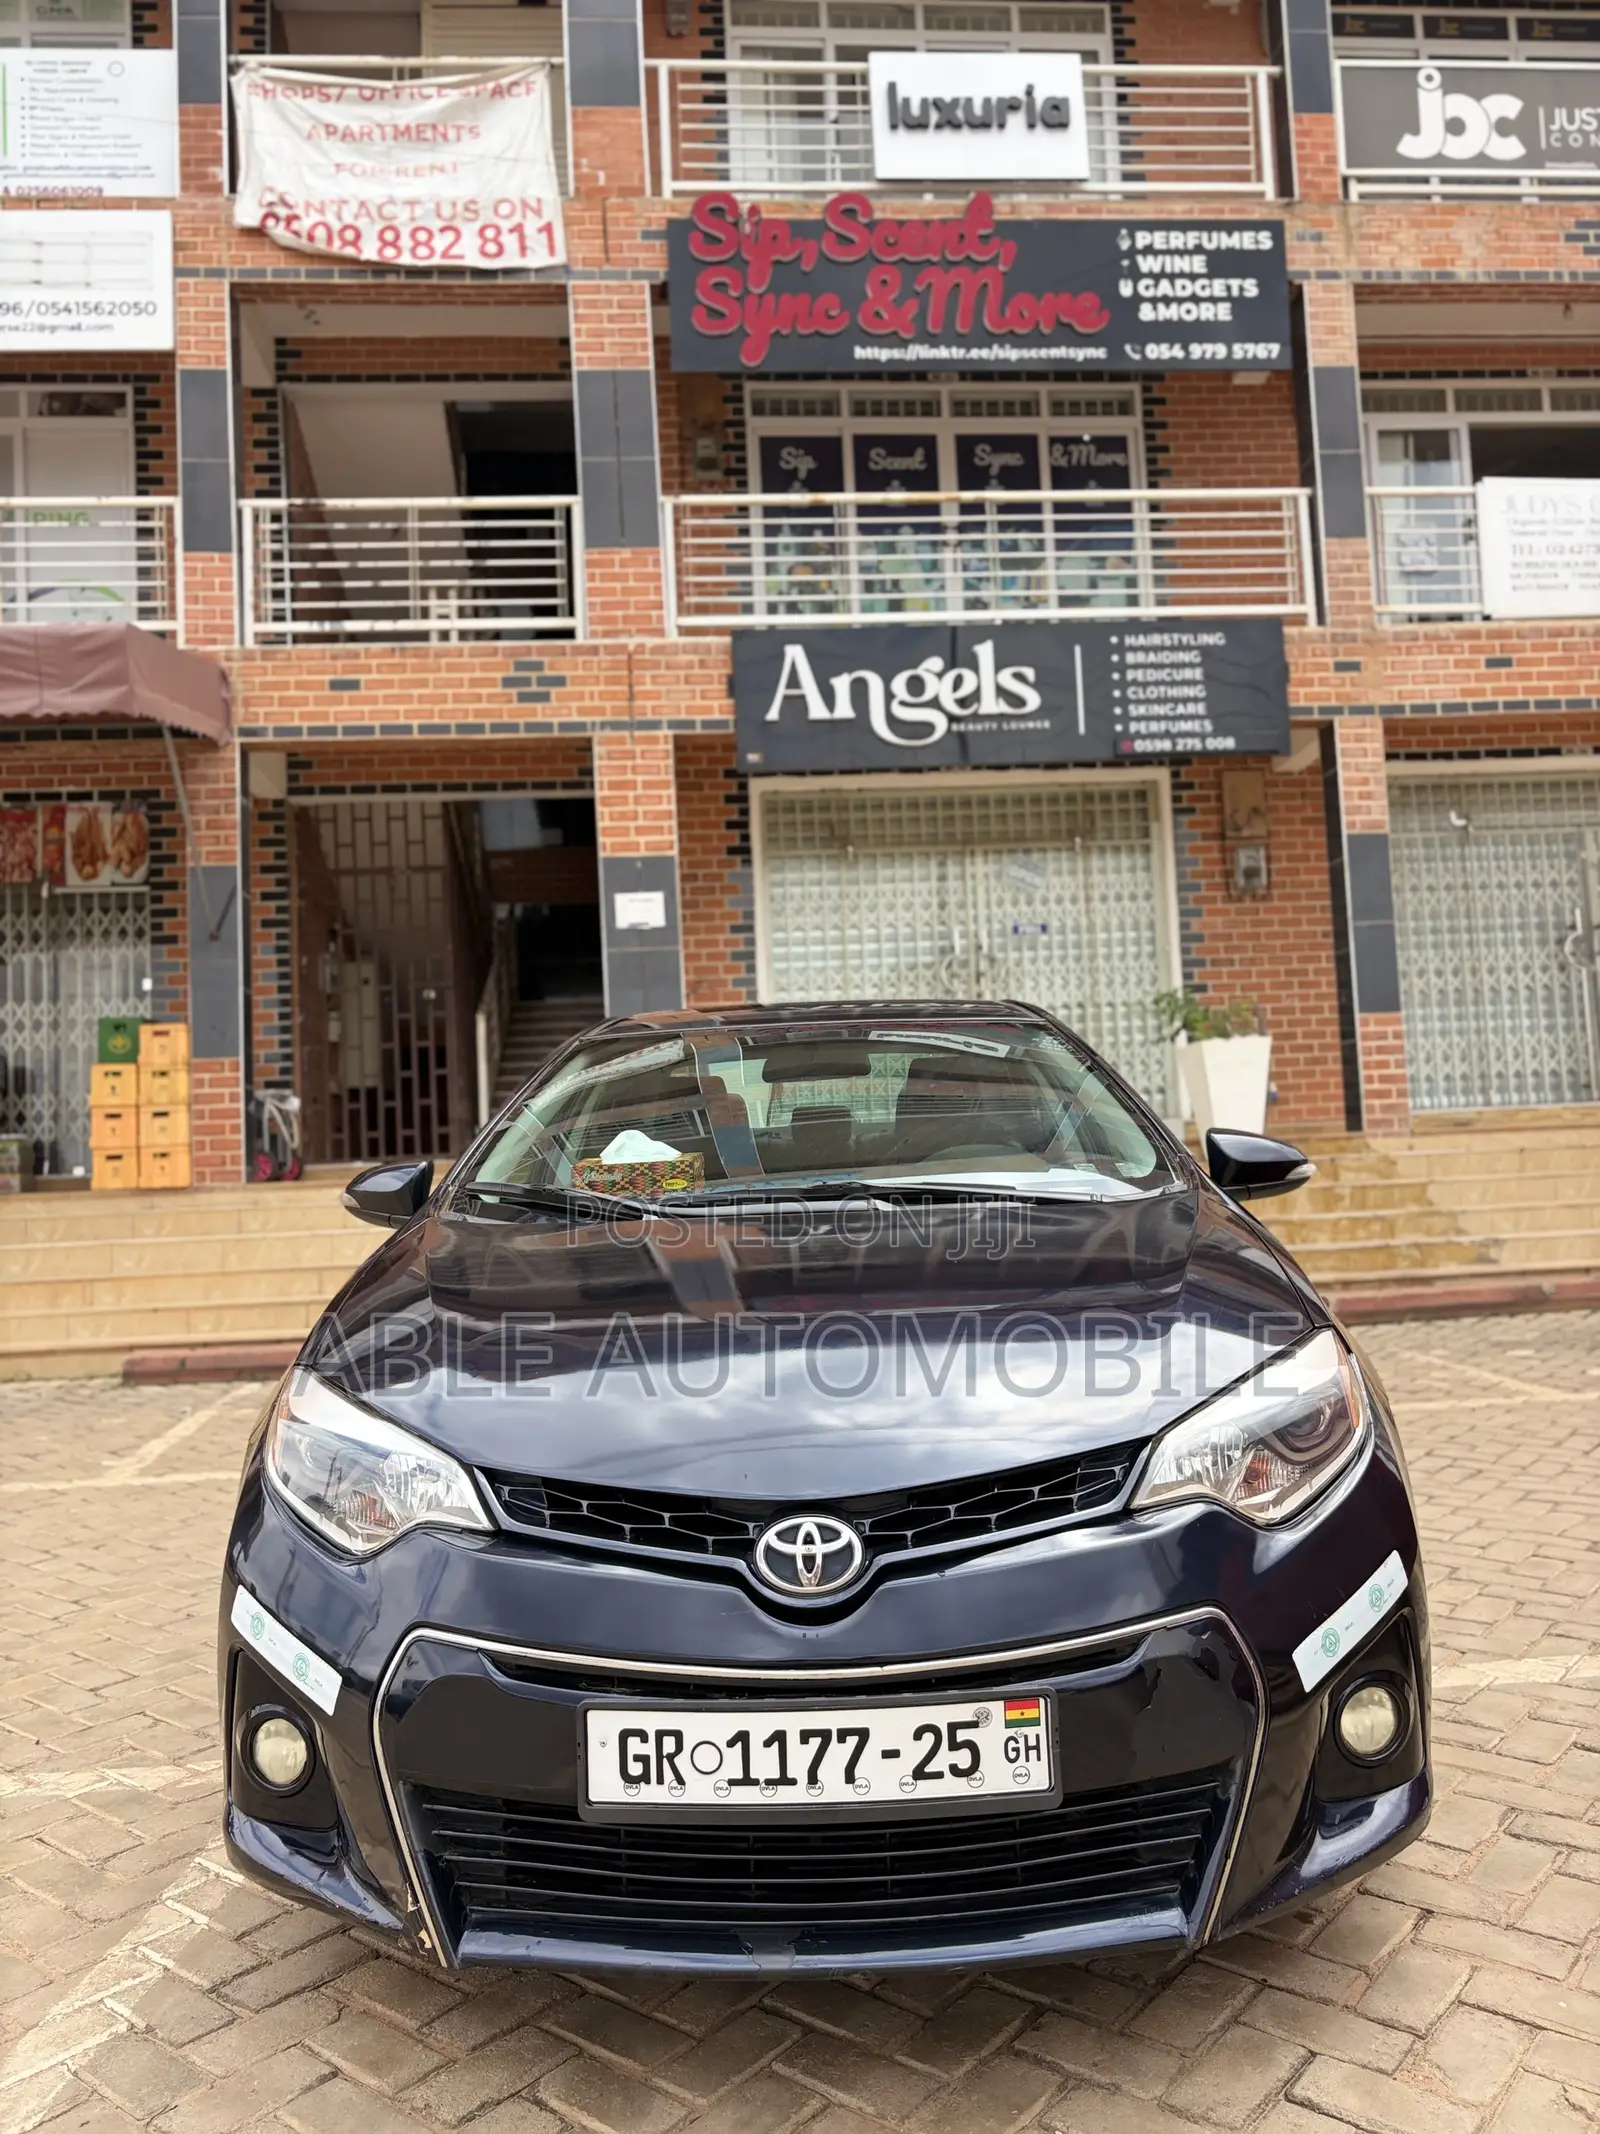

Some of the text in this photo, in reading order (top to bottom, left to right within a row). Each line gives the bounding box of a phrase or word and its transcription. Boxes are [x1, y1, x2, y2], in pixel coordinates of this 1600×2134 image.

[886, 81, 1071, 130] luxuria
[306, 122, 482, 144] APARTMENTS
[435, 199, 480, 222] US
[493, 196, 543, 220] ON
[377, 224, 465, 261] 882
[477, 221, 556, 260] 811
[1134, 230, 1274, 251] PERFUMES
[1135, 254, 1208, 274] WINE
[1136, 278, 1260, 298] GADGETS
[691, 265, 851, 367] Sync
[1137, 301, 1233, 322] &MORE
[1144, 342, 1281, 360] 054 979 5767
[778, 446, 818, 480] Sip
[867, 447, 928, 472] Scent
[973, 443, 1026, 476] Sync
[1124, 632, 1227, 648] HAIRSTYLING
[1125, 650, 1202, 666] BRAIDING
[1125, 667, 1205, 682] PEDICURE
[764, 639, 1042, 747] Angels
[1126, 684, 1207, 700] CLOTHING
[1127, 702, 1208, 718] SKINCARE
[1128, 719, 1214, 735] PERFUMES
[618, 1719, 981, 1787] GR 1177-25
[1003, 1731, 1042, 1765] GH
